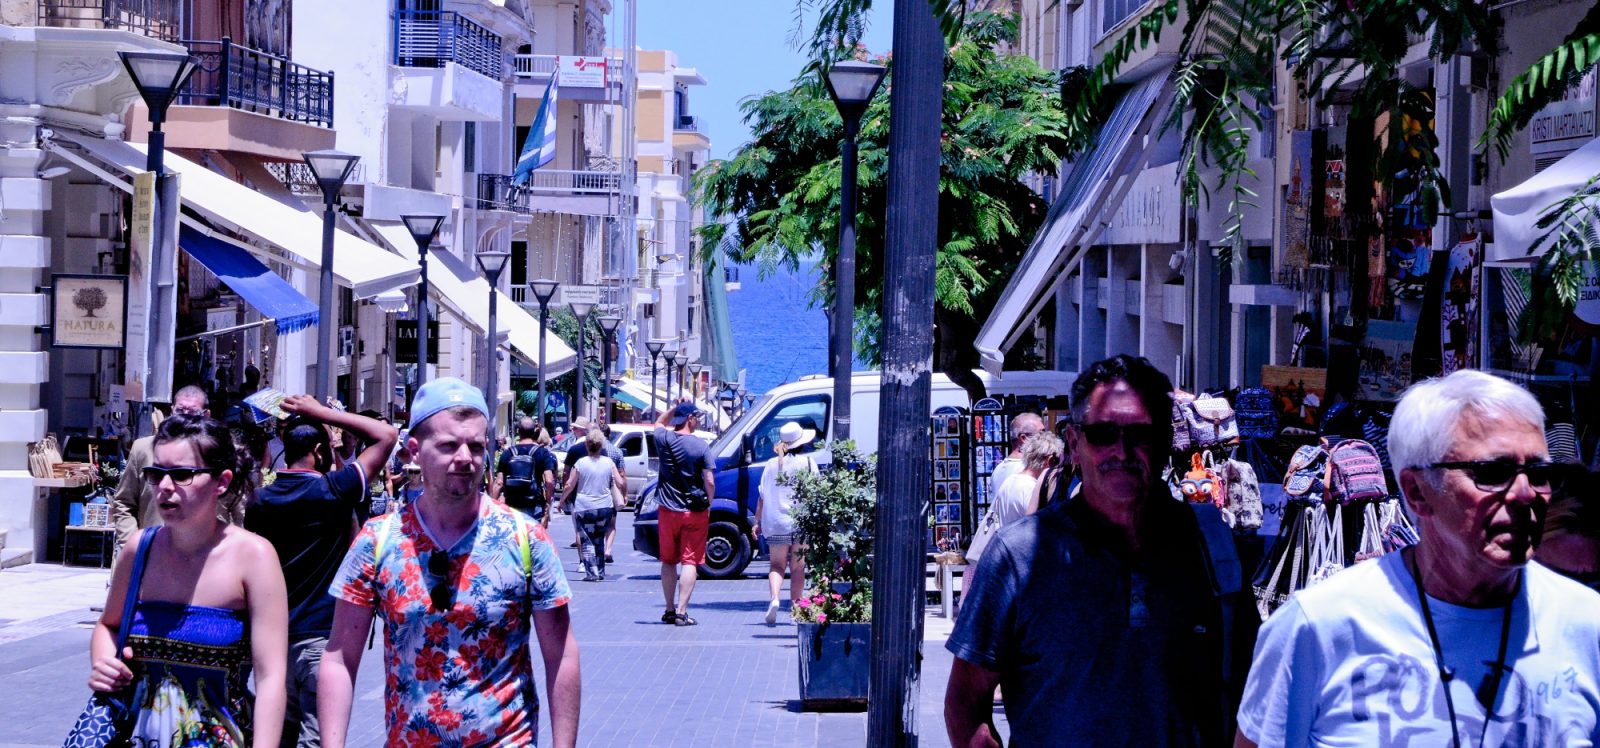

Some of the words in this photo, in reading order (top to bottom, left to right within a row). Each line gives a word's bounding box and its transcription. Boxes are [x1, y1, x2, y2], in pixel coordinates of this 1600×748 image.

[1532, 116, 1553, 140] KRISTI
[63, 320, 116, 330] NATURA
[398, 327, 435, 339] LAL
[1527, 666, 1578, 718] 1967
